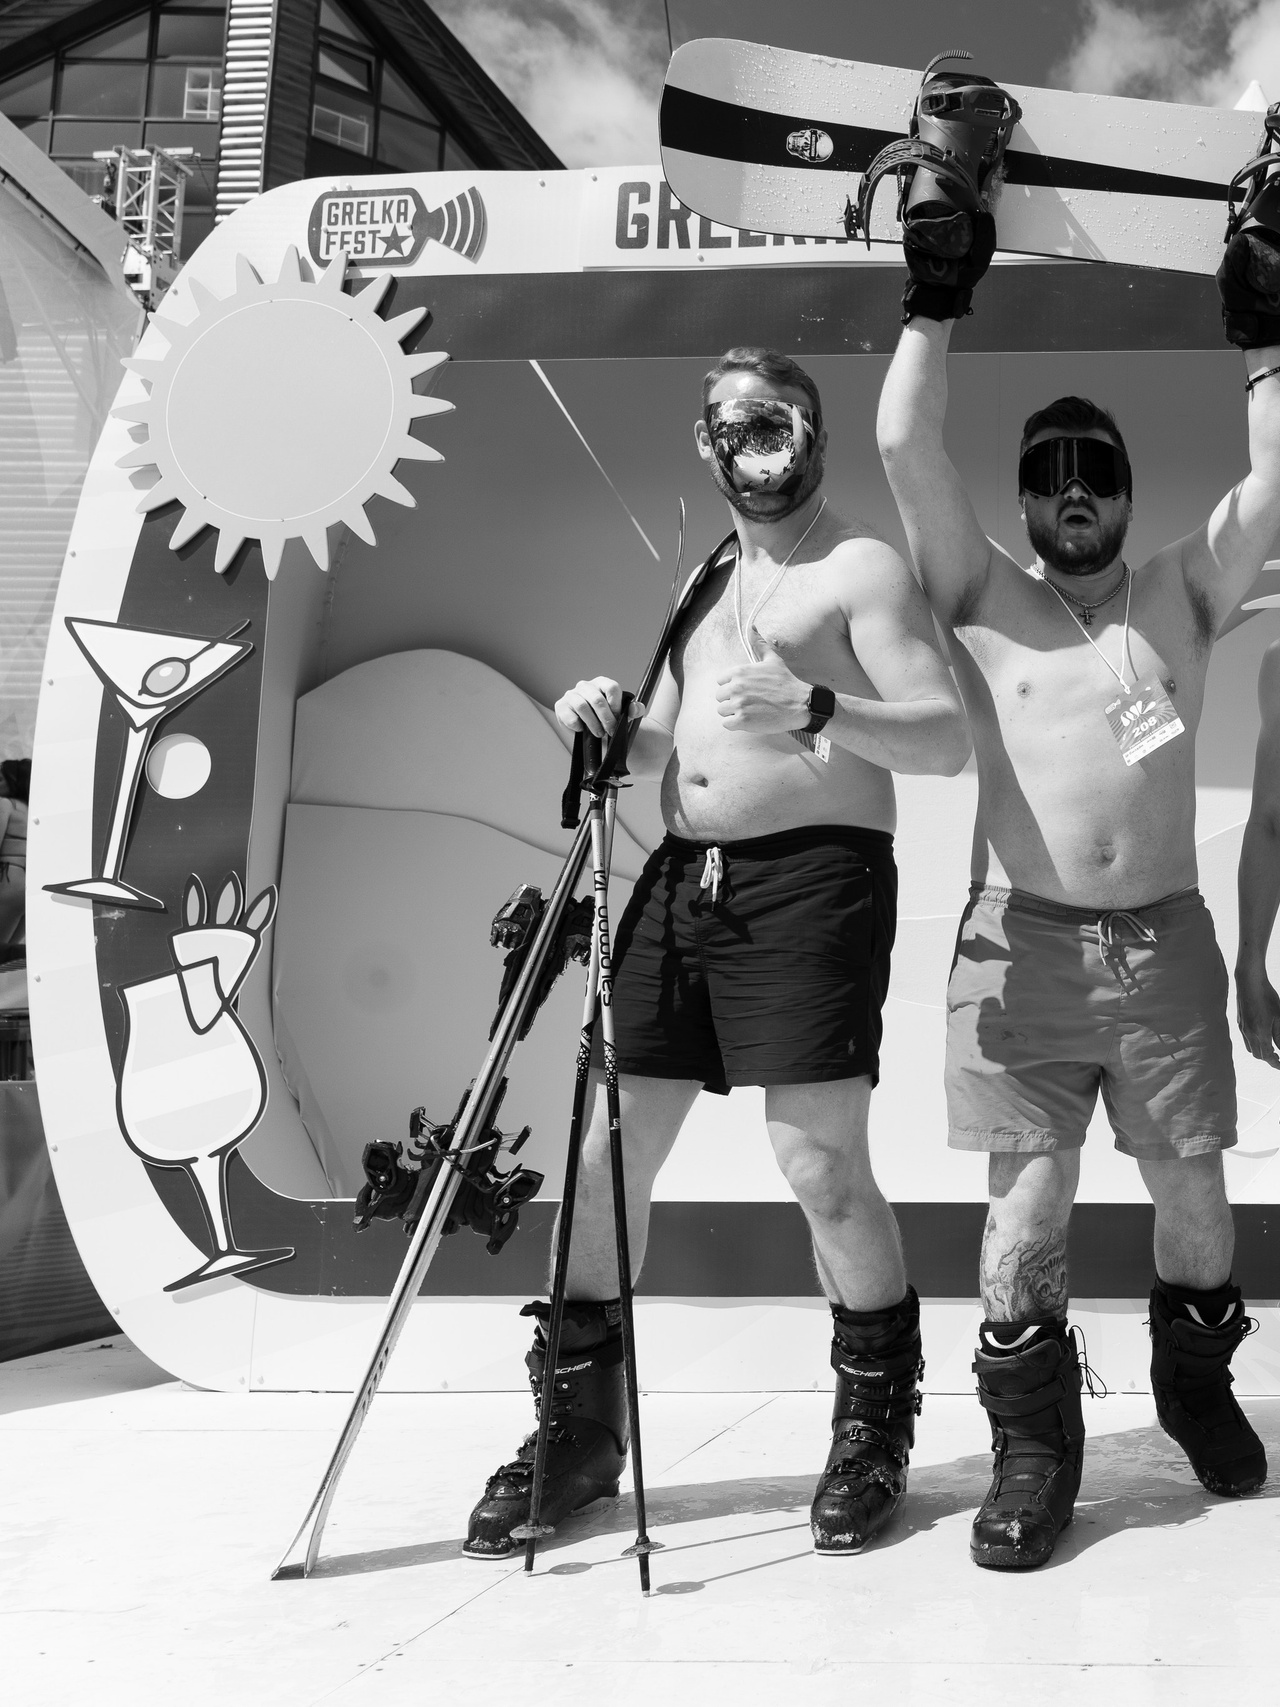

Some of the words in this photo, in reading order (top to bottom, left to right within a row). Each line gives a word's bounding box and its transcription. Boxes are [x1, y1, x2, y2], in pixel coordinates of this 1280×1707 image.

[327, 199, 409, 226] GRELKA
[325, 229, 381, 255] FEST
[1132, 716, 1158, 739] 208
[554, 1361, 593, 1375] SCHER
[839, 1364, 884, 1378] FISCHER
